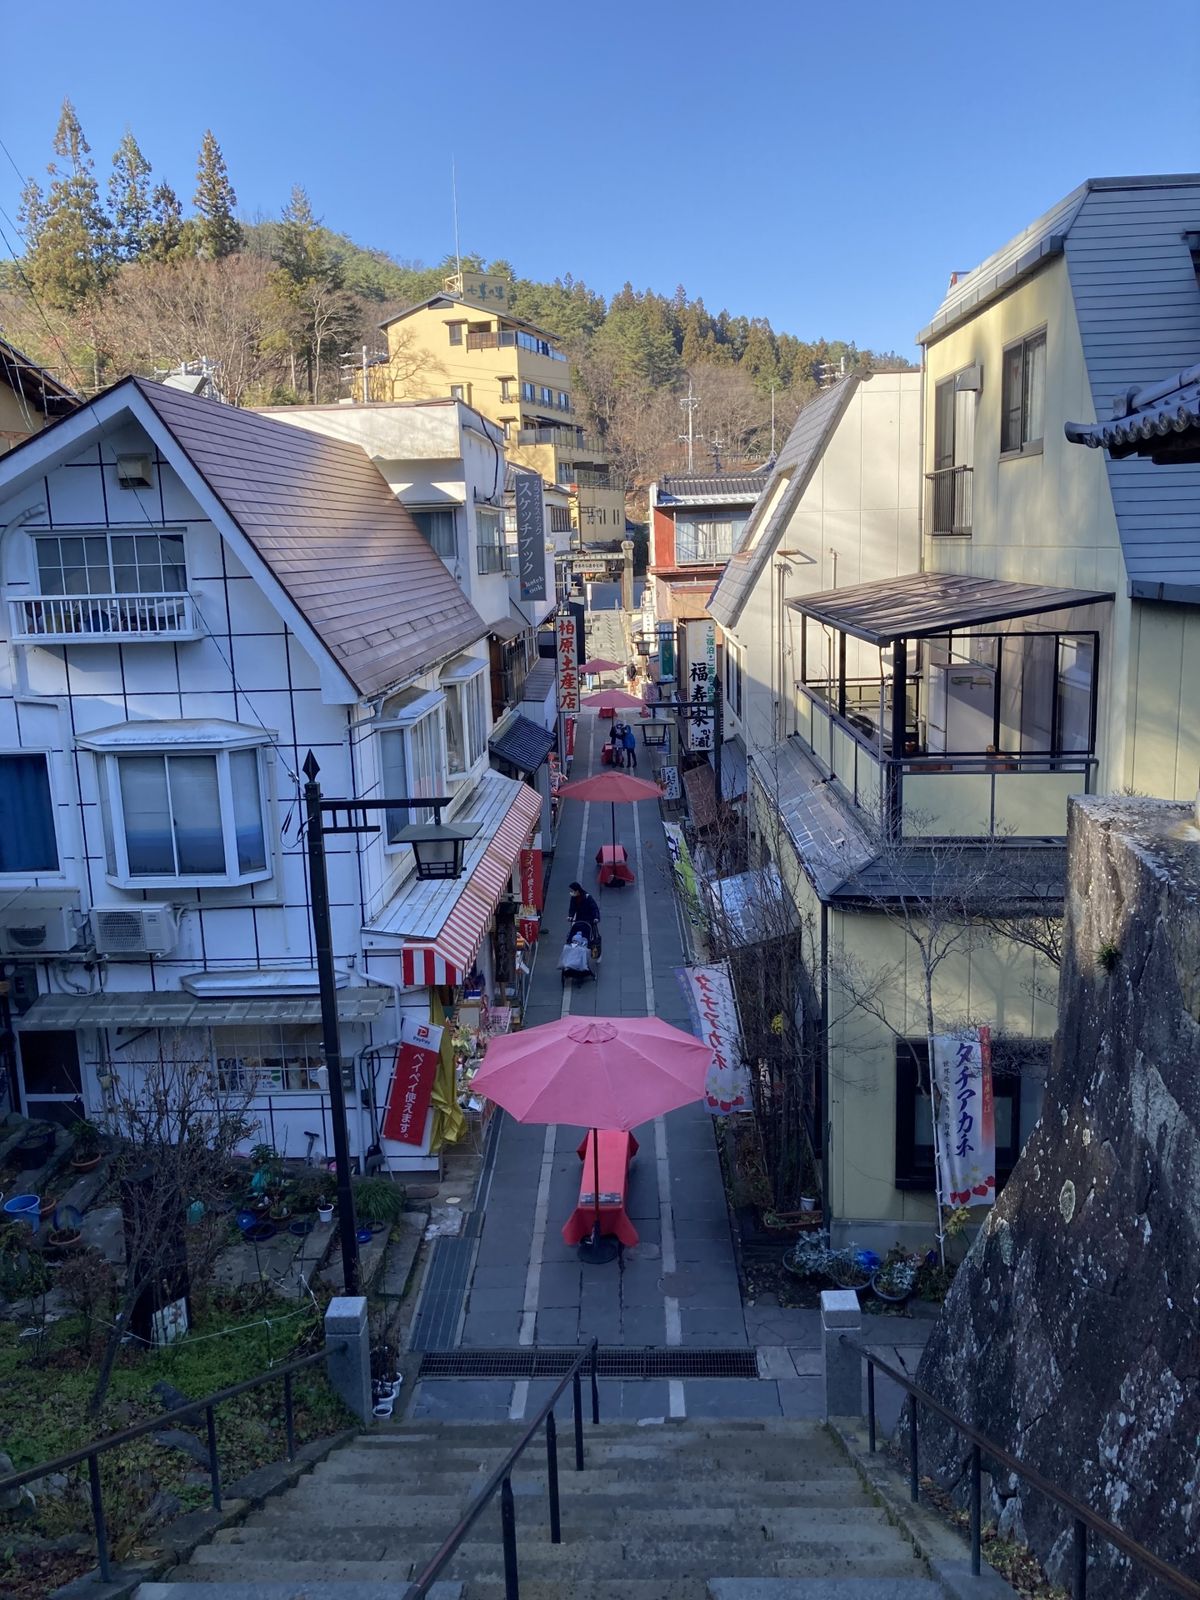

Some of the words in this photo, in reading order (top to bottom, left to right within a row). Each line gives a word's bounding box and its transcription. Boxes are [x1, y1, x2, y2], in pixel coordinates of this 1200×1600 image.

[559, 620, 577, 709] 柏原土産店
[400, 1052, 424, 1138] ペイペイ使えます。
[955, 1042, 976, 1157] タチアカネ
